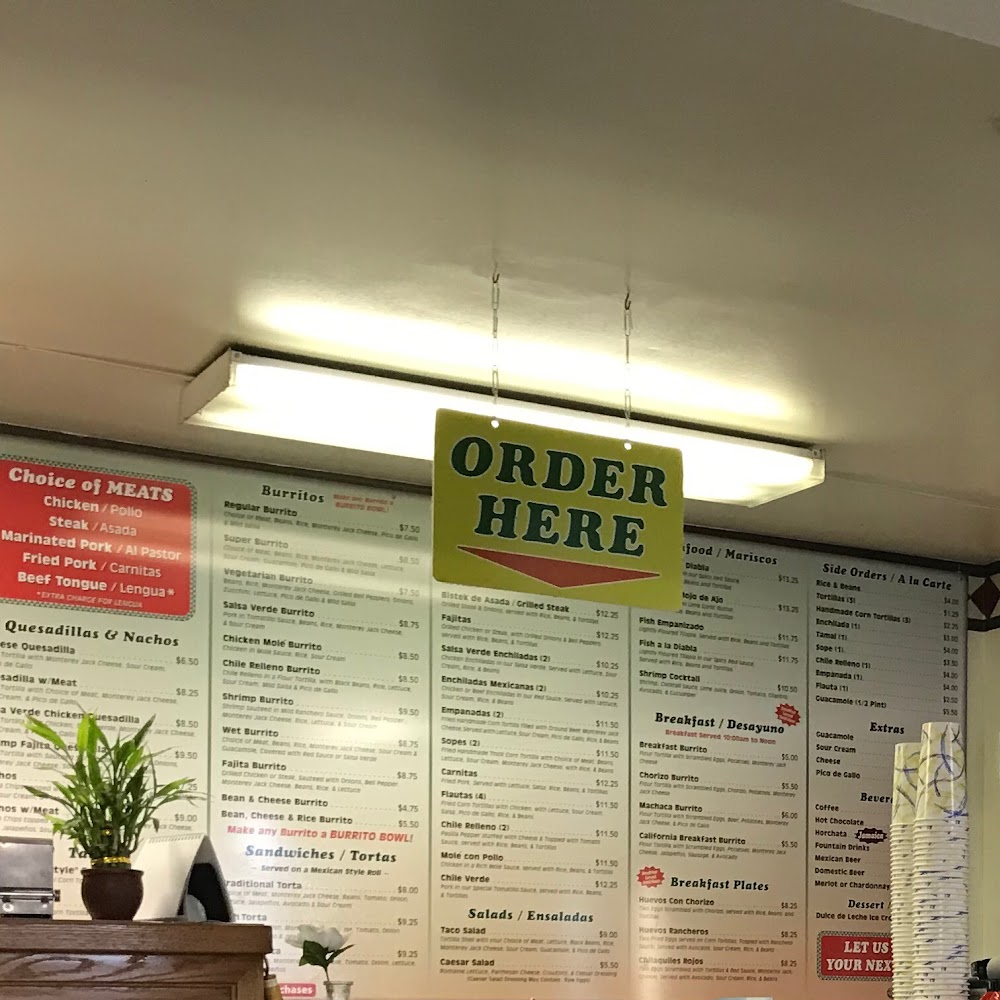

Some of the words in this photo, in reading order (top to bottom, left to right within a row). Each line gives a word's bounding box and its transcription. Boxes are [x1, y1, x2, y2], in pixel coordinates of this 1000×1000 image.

[451, 436, 668, 507] ORDER
[9, 467, 76, 489] Choice
[82, 479, 101, 496] of
[107, 481, 173, 502] MEATS
[262, 485, 325, 503] Burritos
[44, 496, 99, 512] Chicken
[110, 504, 143, 517] Pollo
[49, 516, 89, 530] Steak
[100, 522, 137, 536] Asada
[224, 501, 260, 512] Regular
[264, 506, 297, 517] Burrito
[400, 524, 420, 533] $7.50
[474, 495, 645, 557] HERE
[1, 530, 76, 548] Marinated
[80, 539, 112, 553] Pork
[126, 545, 138, 556] Al
[141, 547, 182, 560] Pastor
[682, 543, 712, 556] food
[725, 549, 777, 565] Mariscos
[23, 553, 60, 566] Fried
[64, 557, 96, 570] Pork
[109, 563, 161, 578] Carnitas
[18, 572, 51, 585] Beef
[55, 575, 107, 591] Tongue
[823, 564, 846, 575] Side
[850, 567, 886, 581] Orders
[898, 574, 905, 583] A
[909, 576, 919, 585] la
[923, 578, 952, 590] Carte
[5, 620, 99, 639] Quesadillas
[105, 630, 118, 640] &
[124, 631, 179, 646] Nachos
[658, 620, 704, 631] Empanizado
[655, 713, 715, 728] Breakfast
[727, 719, 784, 734] Desayuno
[870, 722, 904, 734] Extras
[816, 732, 854, 740] Guacamole
[222, 794, 245, 802] Bean
[258, 796, 291, 805] Cheese
[295, 799, 328, 807] Burrito
[398, 804, 418, 812] $4.75
[830, 818, 864, 826] Chocolate
[228, 826, 254, 834] Make
[258, 827, 276, 837] any
[281, 829, 317, 838] Burrito
[330, 830, 375, 840] BURRITO
[380, 833, 413, 842] BOWL!
[639, 832, 677, 840] California
[679, 835, 716, 843] Breakfast
[719, 837, 745, 845] Burrito
[245, 845, 334, 860] Sandwiches
[350, 850, 396, 862] Tortas
[441, 874, 462, 883] Chile
[465, 875, 489, 883] Verde
[671, 877, 729, 890] Breakfast
[734, 880, 769, 891] Plates
[848, 900, 884, 909] Dessert
[468, 909, 513, 920] Salads
[528, 911, 593, 922] Ensaladas
[844, 941, 869, 953] LET
[873, 942, 889, 953] US
[827, 959, 862, 971] YOUR
[865, 959, 892, 971] NEX
